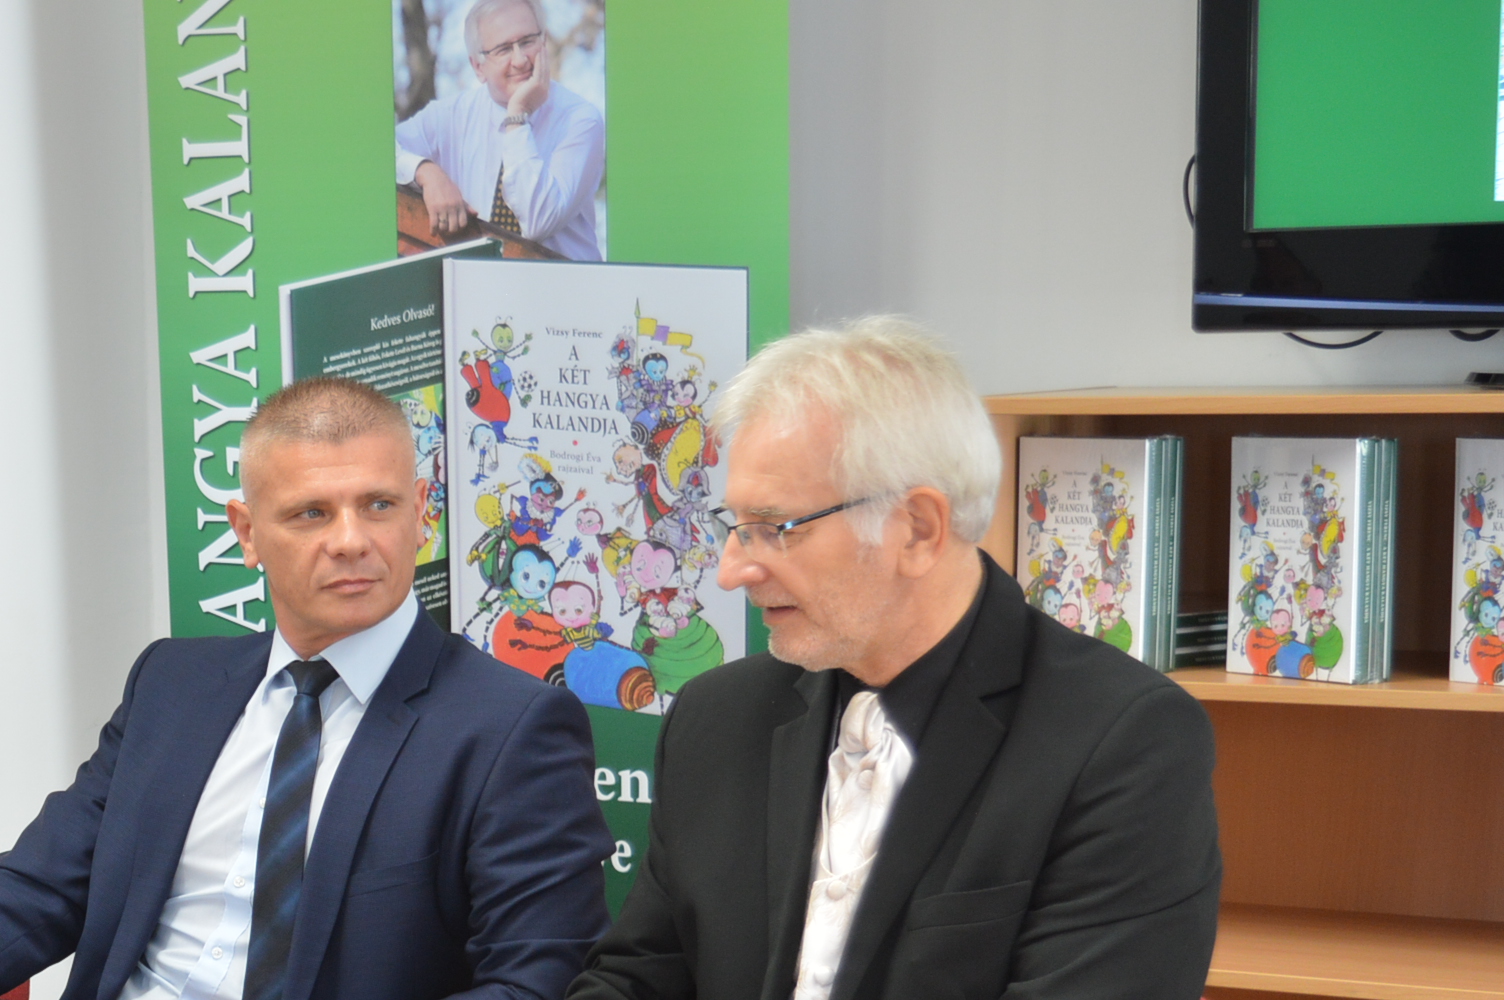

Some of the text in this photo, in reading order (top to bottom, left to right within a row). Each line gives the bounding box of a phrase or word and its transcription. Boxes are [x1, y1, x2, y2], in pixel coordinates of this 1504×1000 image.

[370, 304, 435, 331] Kedves Olvasó!
[545, 327, 603, 339] Vizsy Ferenc
[568, 345, 580, 361] A
[558, 364, 590, 385] KÉT
[539, 390, 611, 411] HANGYA
[532, 412, 620, 437] KALANDJA
[549, 450, 602, 463] Bodrogi Éva
[557, 464, 594, 475] rajzaival
[1058, 503, 1090, 513] HANGYA
[1269, 506, 1301, 516] HANGYA
[1054, 515, 1093, 526] KALANDJA
[1266, 518, 1304, 529] KALANDJA
